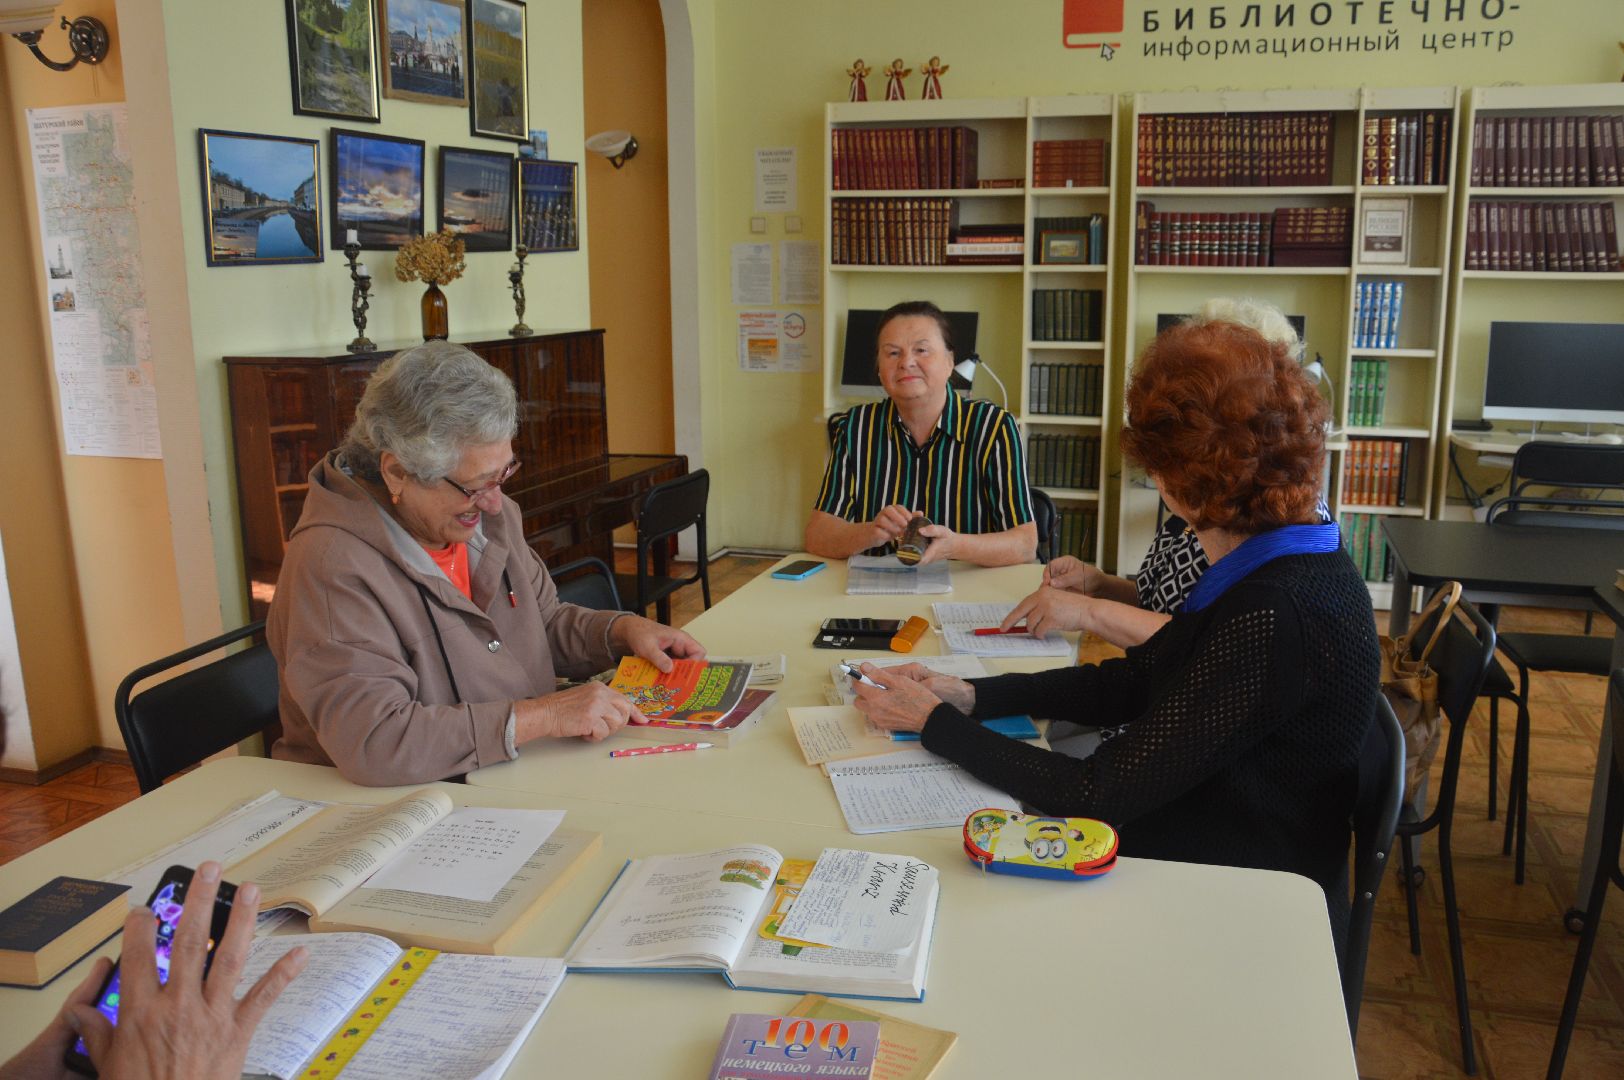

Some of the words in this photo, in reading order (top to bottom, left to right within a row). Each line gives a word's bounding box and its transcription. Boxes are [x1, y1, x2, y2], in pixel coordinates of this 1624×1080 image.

[1142, 0, 1521, 33] БИБЛИОТЕЧНО-
[1143, 28, 1400, 61] информационный
[1421, 28, 1514, 53] центр
[764, 1016, 850, 1052] 100
[723, 1057, 811, 1073] немецкого
[815, 1064, 870, 1076] языка
